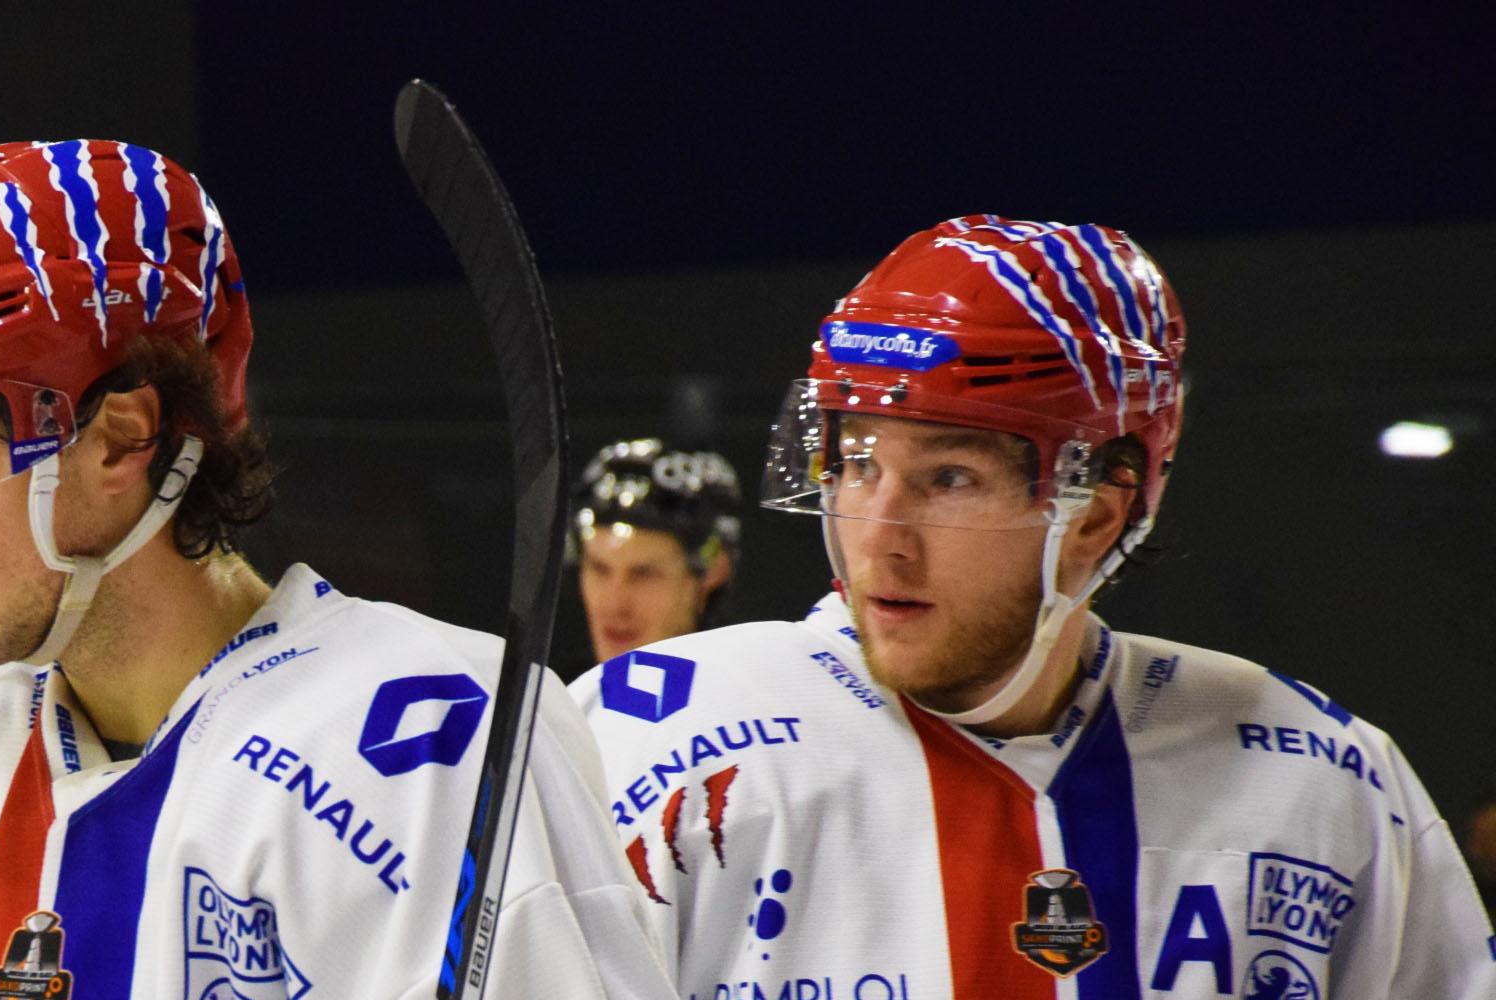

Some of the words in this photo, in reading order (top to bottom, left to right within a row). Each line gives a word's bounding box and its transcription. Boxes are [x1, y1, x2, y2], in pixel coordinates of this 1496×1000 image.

[611, 716, 801, 826] RENAULT
[1237, 723, 1386, 793] RENA
[233, 734, 411, 894] RENAUL
[1151, 884, 1234, 995] A
